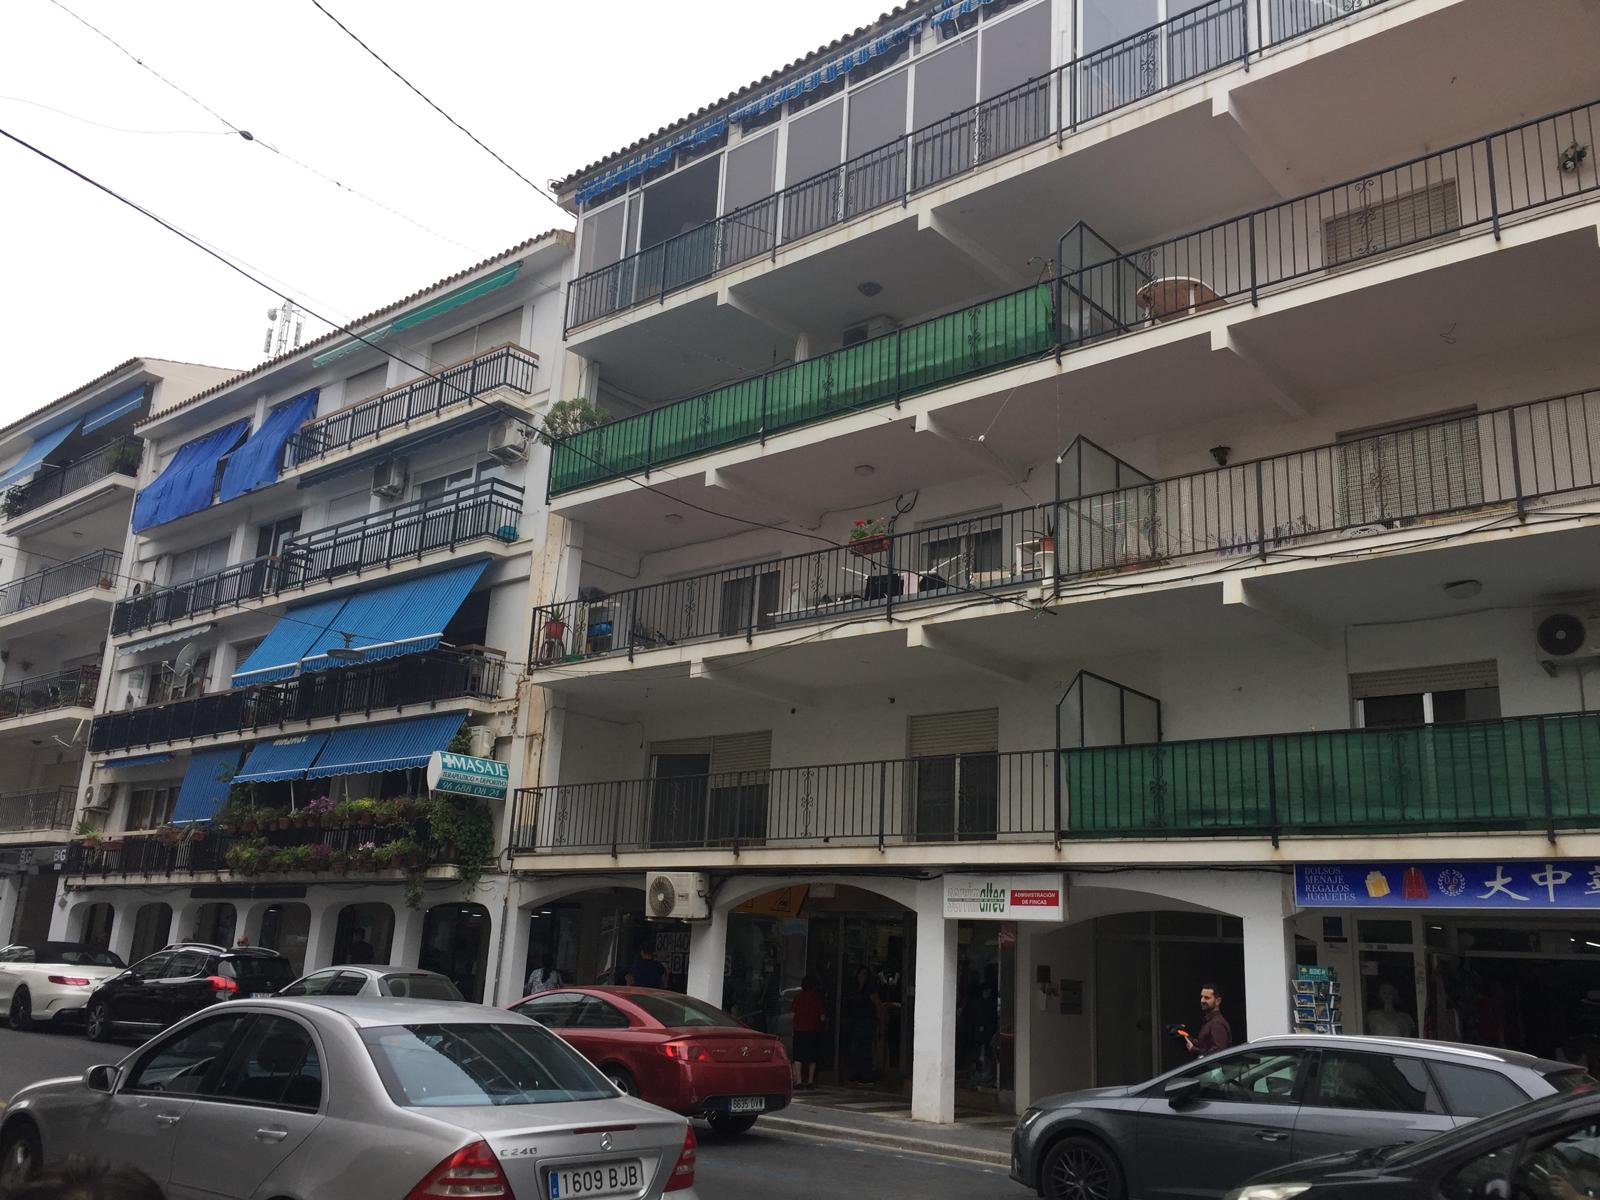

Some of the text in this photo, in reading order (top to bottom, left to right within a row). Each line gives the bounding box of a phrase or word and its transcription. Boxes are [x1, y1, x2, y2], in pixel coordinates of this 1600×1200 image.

[453, 756, 508, 778] MASAJE
[442, 782, 452, 790] 96
[1304, 866, 1341, 875] BOLSOS
[1304, 875, 1345, 884] MENAJE
[1305, 884, 1350, 893] REGALOS
[1014, 891, 1056, 899] ADMINISTRACIÓN
[1305, 892, 1357, 902] JUGUETES
[500, 1149, 509, 1157] C
[562, 1165, 638, 1195] 1609 BJB
